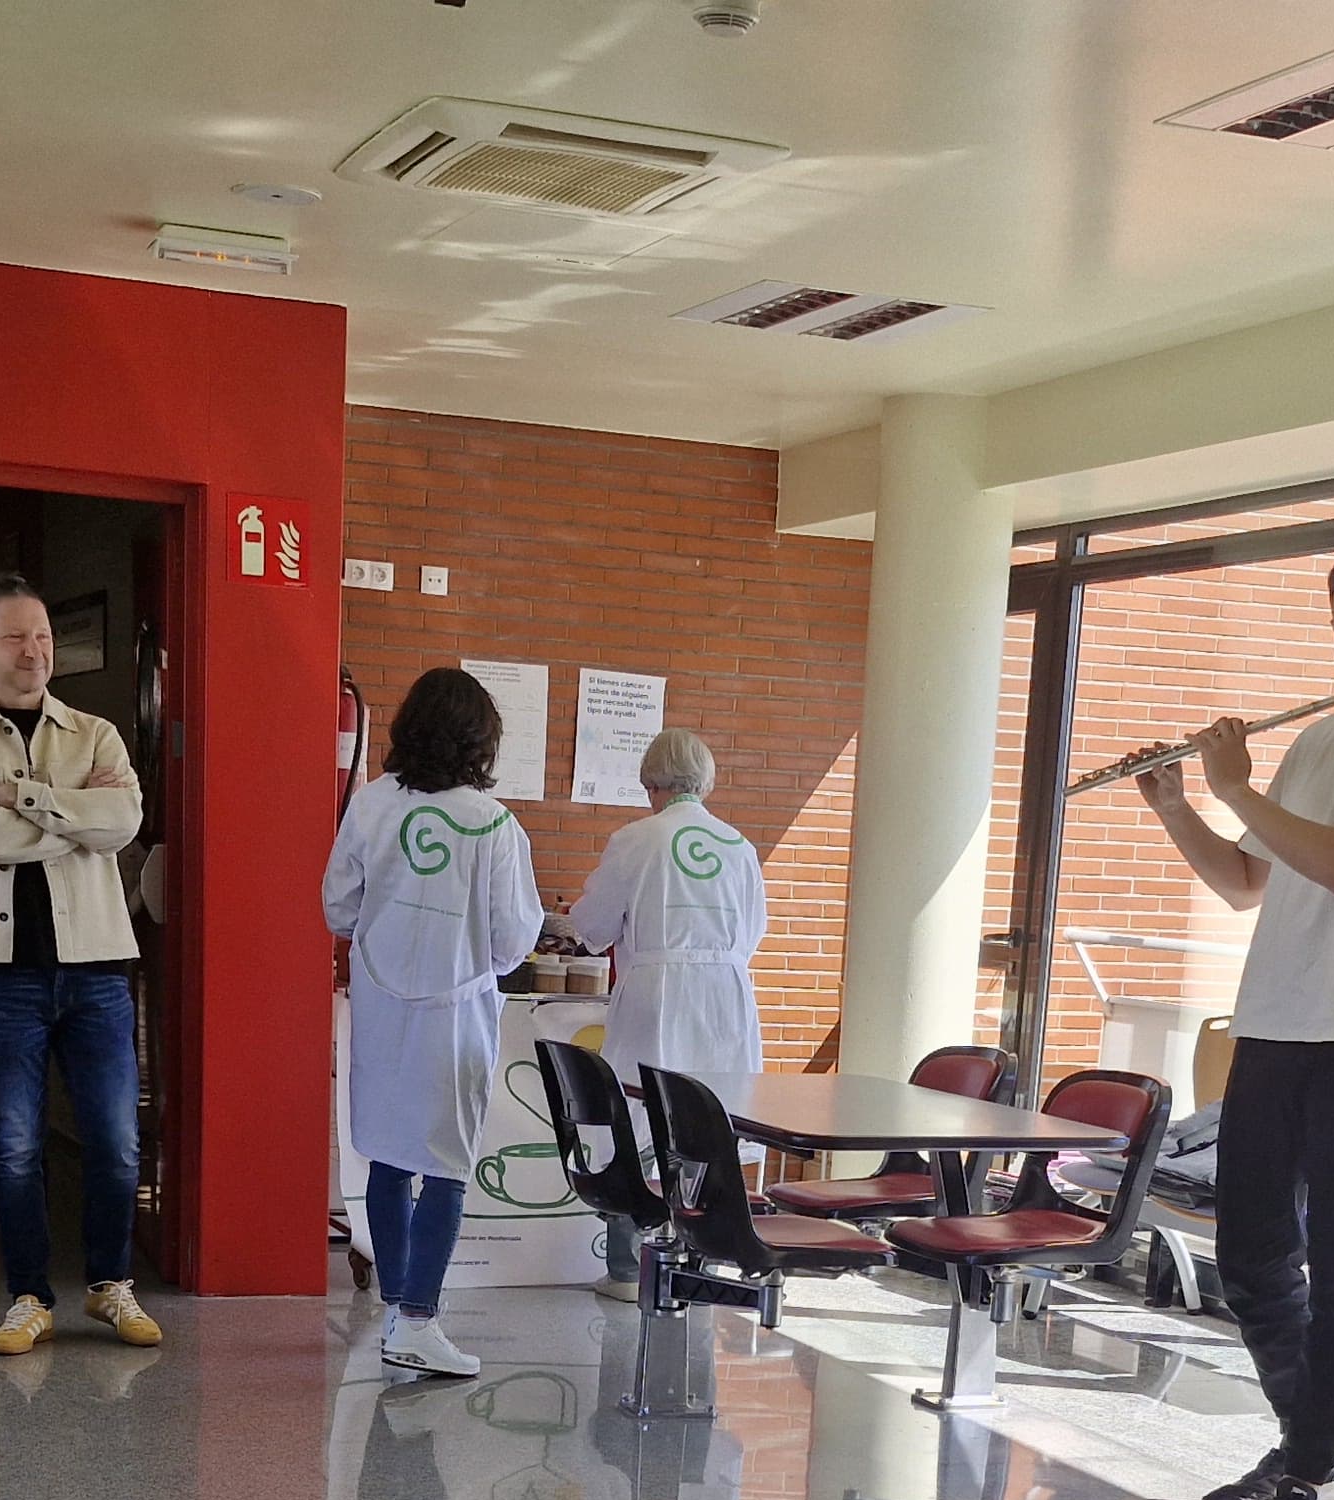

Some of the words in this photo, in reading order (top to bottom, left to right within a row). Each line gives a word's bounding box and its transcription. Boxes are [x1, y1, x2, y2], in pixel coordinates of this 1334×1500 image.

[589, 676, 596, 684] Si
[597, 677, 619, 687] tienes
[620, 680, 645, 689] cáncer
[588, 687, 609, 695] sabes
[622, 690, 649, 700] alguien
[603, 698, 635, 708] necesita
[636, 702, 657, 711] algún
[587, 706, 602, 715] tipo
[603, 707, 613, 715] de
[614, 710, 637, 718] ayuda
